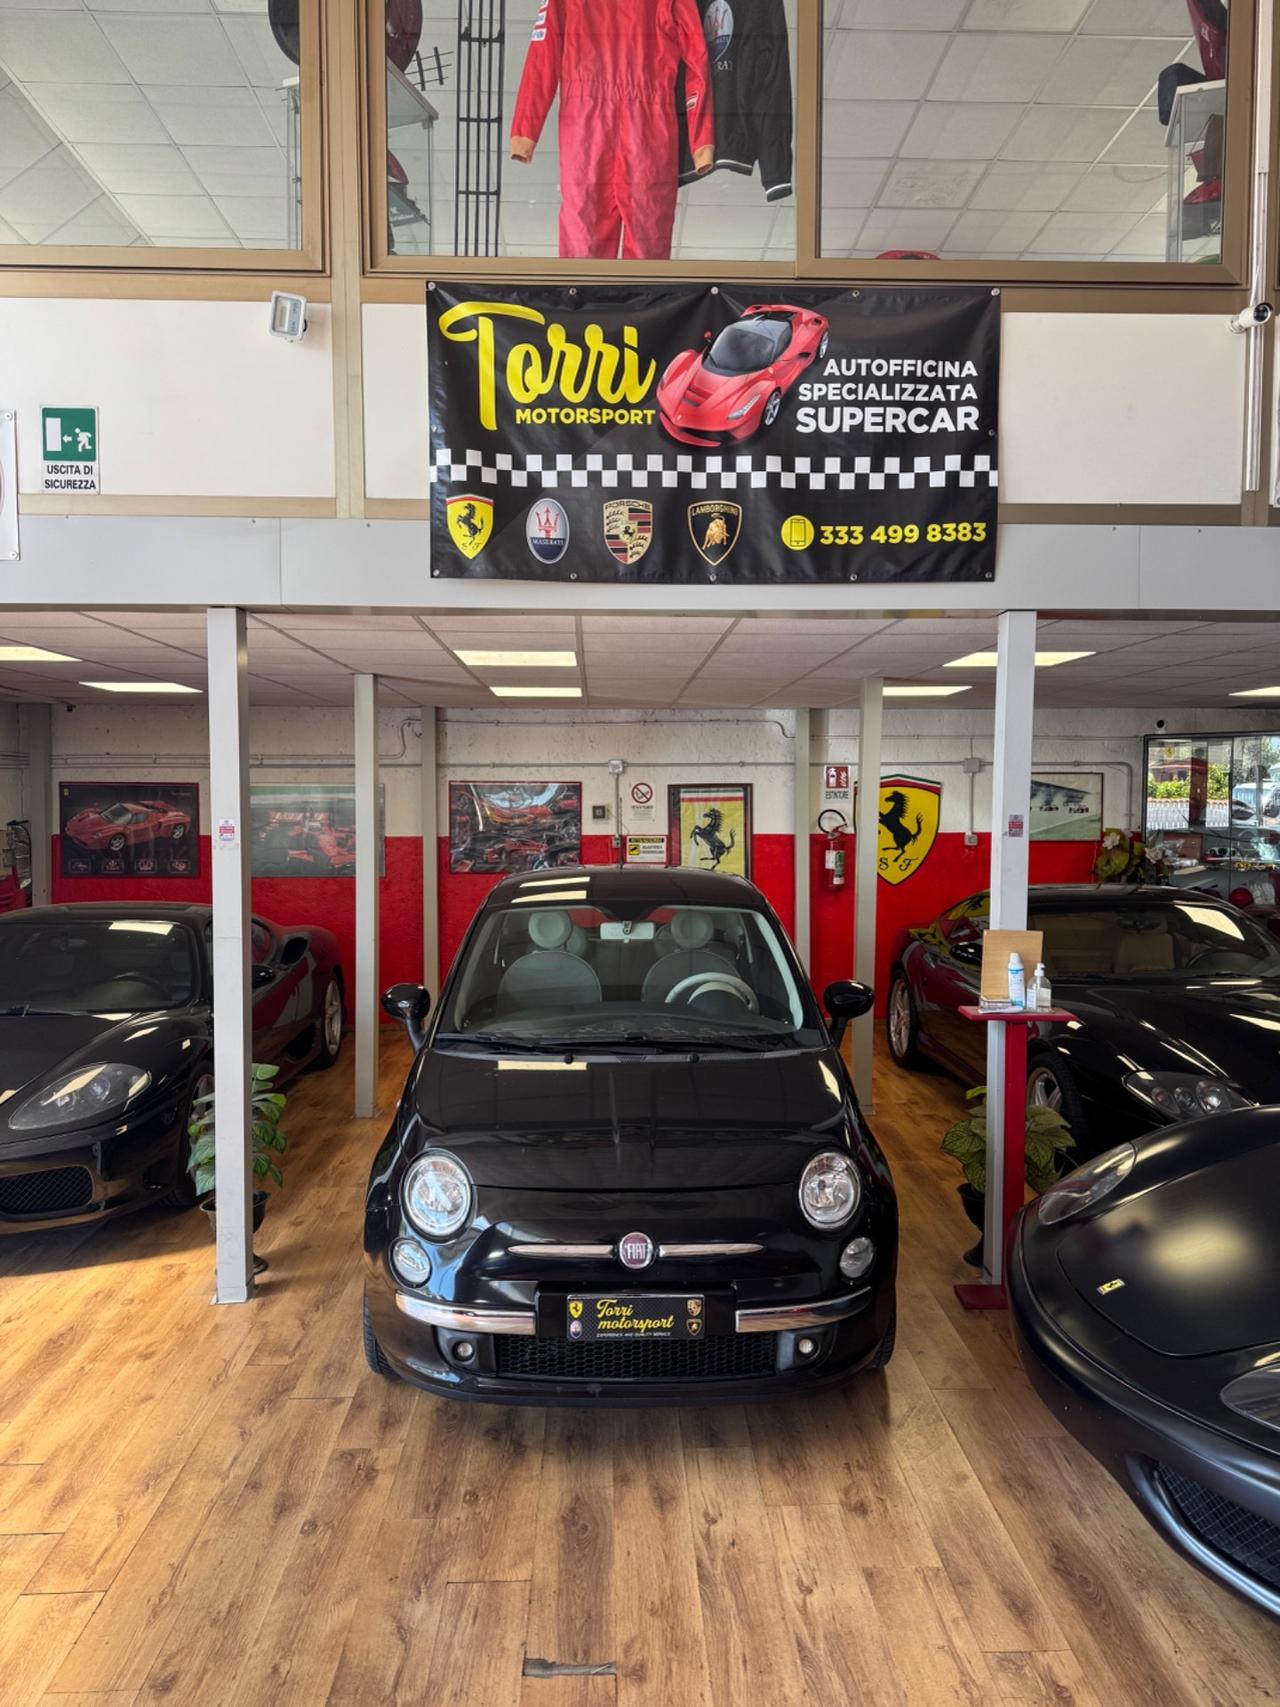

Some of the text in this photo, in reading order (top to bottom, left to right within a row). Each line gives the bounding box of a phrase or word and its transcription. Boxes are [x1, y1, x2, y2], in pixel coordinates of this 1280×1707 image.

[439, 302, 656, 430] Torri
[823, 359, 978, 378] AUTOFFICINA
[798, 383, 978, 402] SPECIALIZZATA
[515, 408, 656, 425] MOTORSPORT
[796, 406, 980, 434] SUPERCAR
[47, 464, 93, 476] USCITA DI
[44, 479, 96, 490] SICUREZZA
[605, 500, 651, 510] PORSCHE
[692, 504, 738, 516] LAMBORGHINI
[820, 522, 987, 544] 333 499 8383
[627, 1243, 648, 1260] FIAT
[596, 1299, 634, 1318] Torri
[597, 1315, 675, 1333] motorsport
